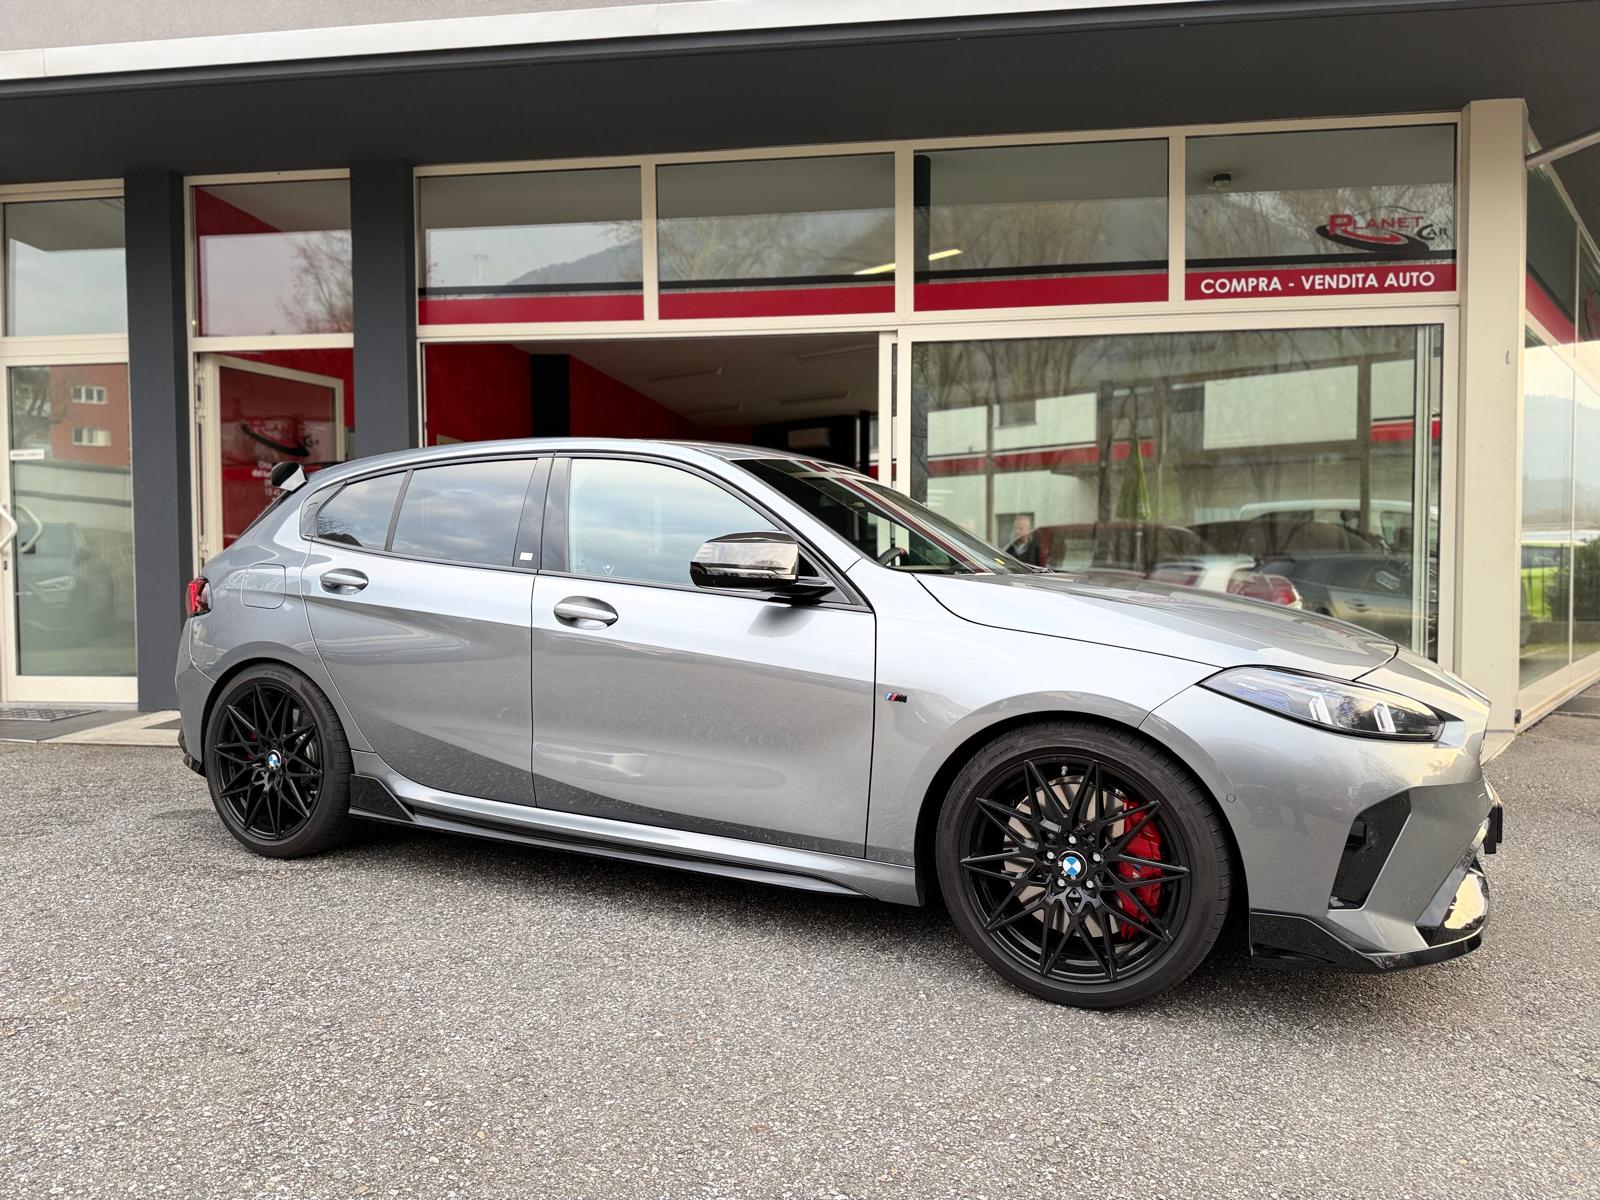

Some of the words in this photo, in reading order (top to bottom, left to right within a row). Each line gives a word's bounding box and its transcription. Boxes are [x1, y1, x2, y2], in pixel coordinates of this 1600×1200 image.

[1417, 224, 1448, 240] CAR
[1200, 276, 1282, 294] COMPRA
[1300, 273, 1379, 290] VENDITA
[1384, 271, 1435, 288] AUTO
